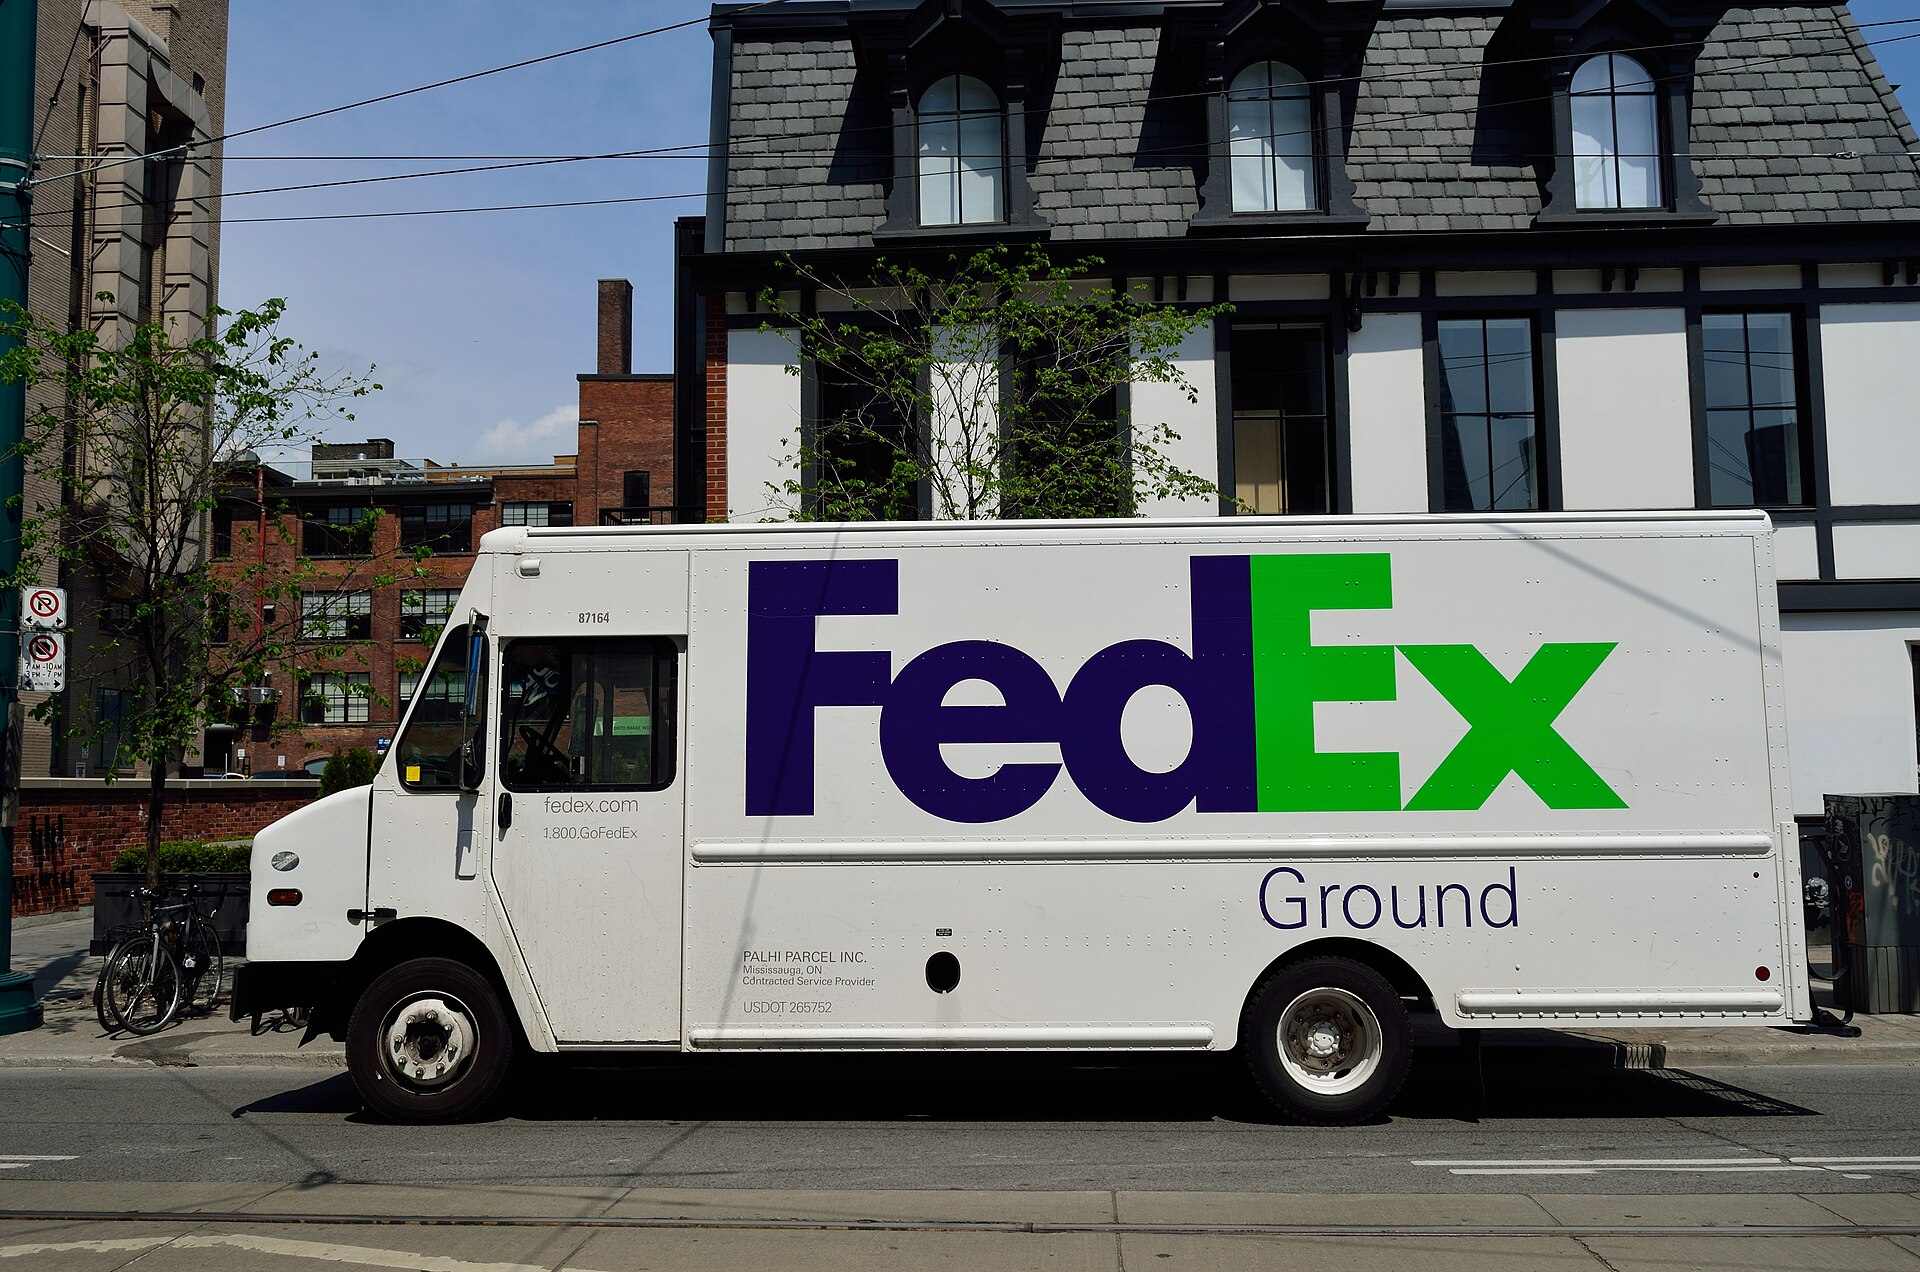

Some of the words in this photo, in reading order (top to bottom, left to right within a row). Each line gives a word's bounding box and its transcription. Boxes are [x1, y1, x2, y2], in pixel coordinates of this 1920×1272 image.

[579, 612, 610, 624] 87164
[25, 662, 30, 670] 7
[25, 670, 30, 678] 3
[47, 670, 52, 678] 7
[746, 554, 1628, 823] FedEx
[544, 796, 639, 813] fedex.com
[544, 826, 638, 840] 1.800.GoFedEx
[1259, 867, 1519, 930] Ground
[743, 951, 781, 963] PALHI
[785, 951, 837, 963] PARCEL
[840, 951, 867, 963] INC.
[743, 965, 804, 976] Mississauga,
[806, 965, 823, 975] ON
[743, 976, 795, 986] Contracted
[797, 976, 833, 986] Service
[835, 976, 876, 986] Provider
[743, 1001, 787, 1014] USDOT
[789, 1001, 832, 1014] 265752
